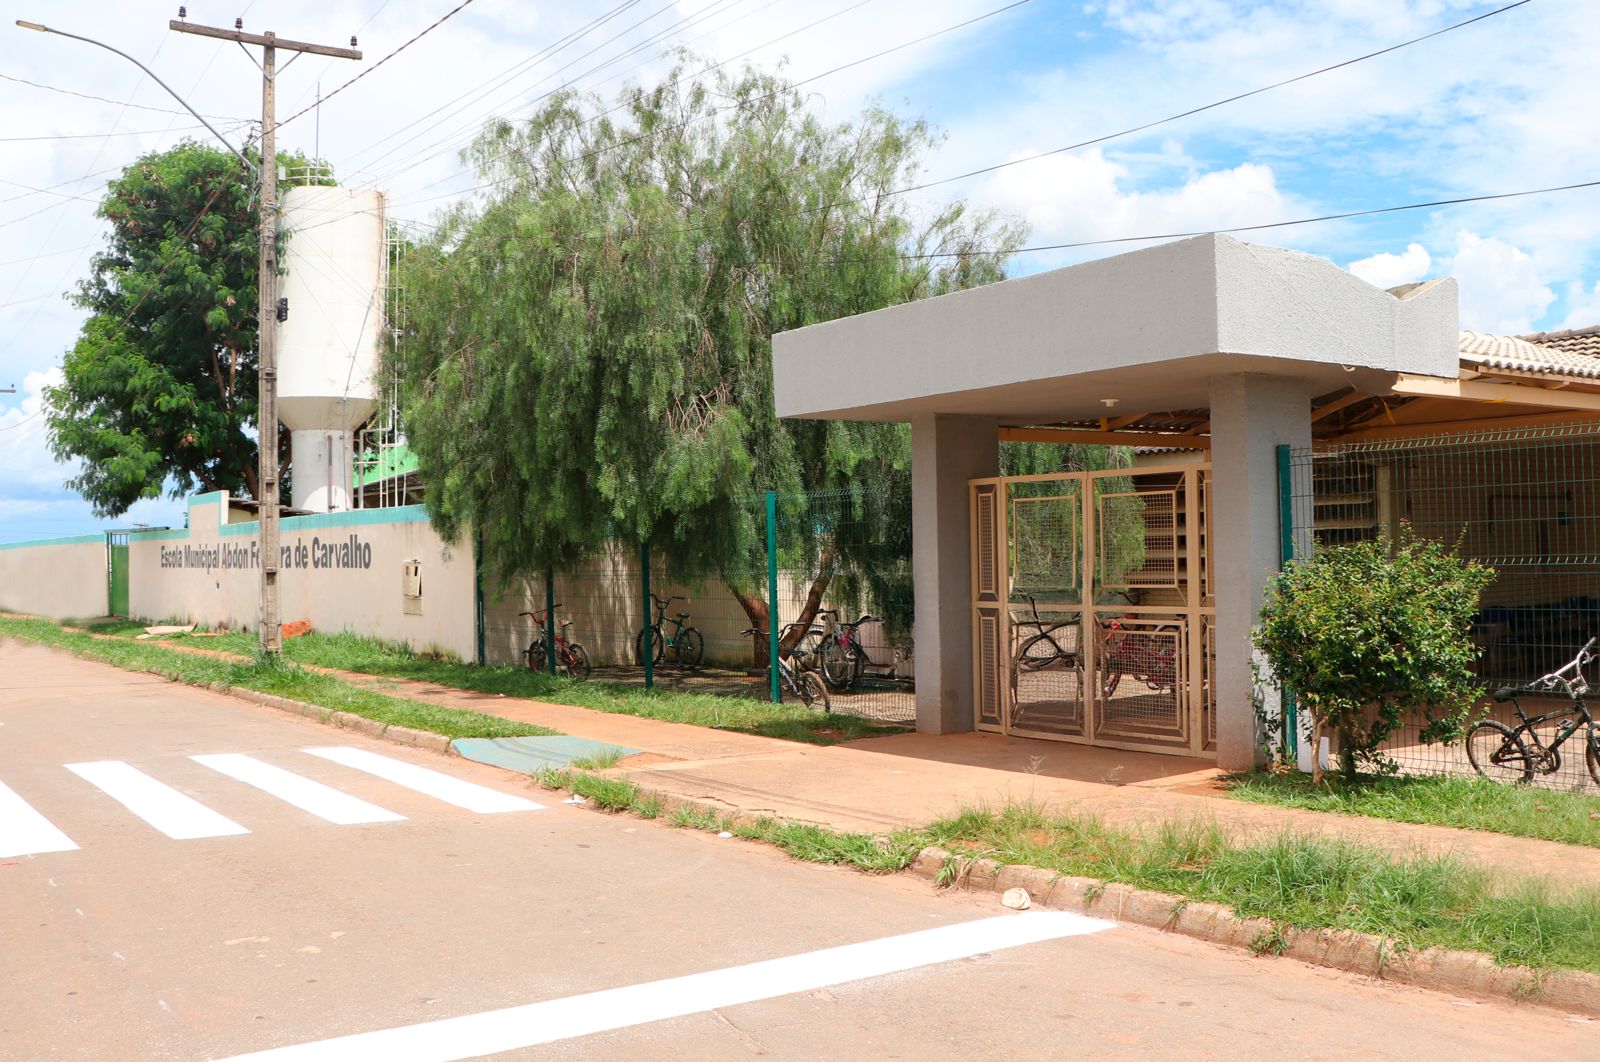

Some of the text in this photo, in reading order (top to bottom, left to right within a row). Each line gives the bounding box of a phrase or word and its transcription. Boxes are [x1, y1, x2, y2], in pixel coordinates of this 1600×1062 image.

[161, 545, 182, 568] Escola
[184, 544, 219, 574] Municipal
[221, 542, 248, 569] Abdon
[295, 537, 308, 569] de
[312, 534, 371, 569] Carvalho
